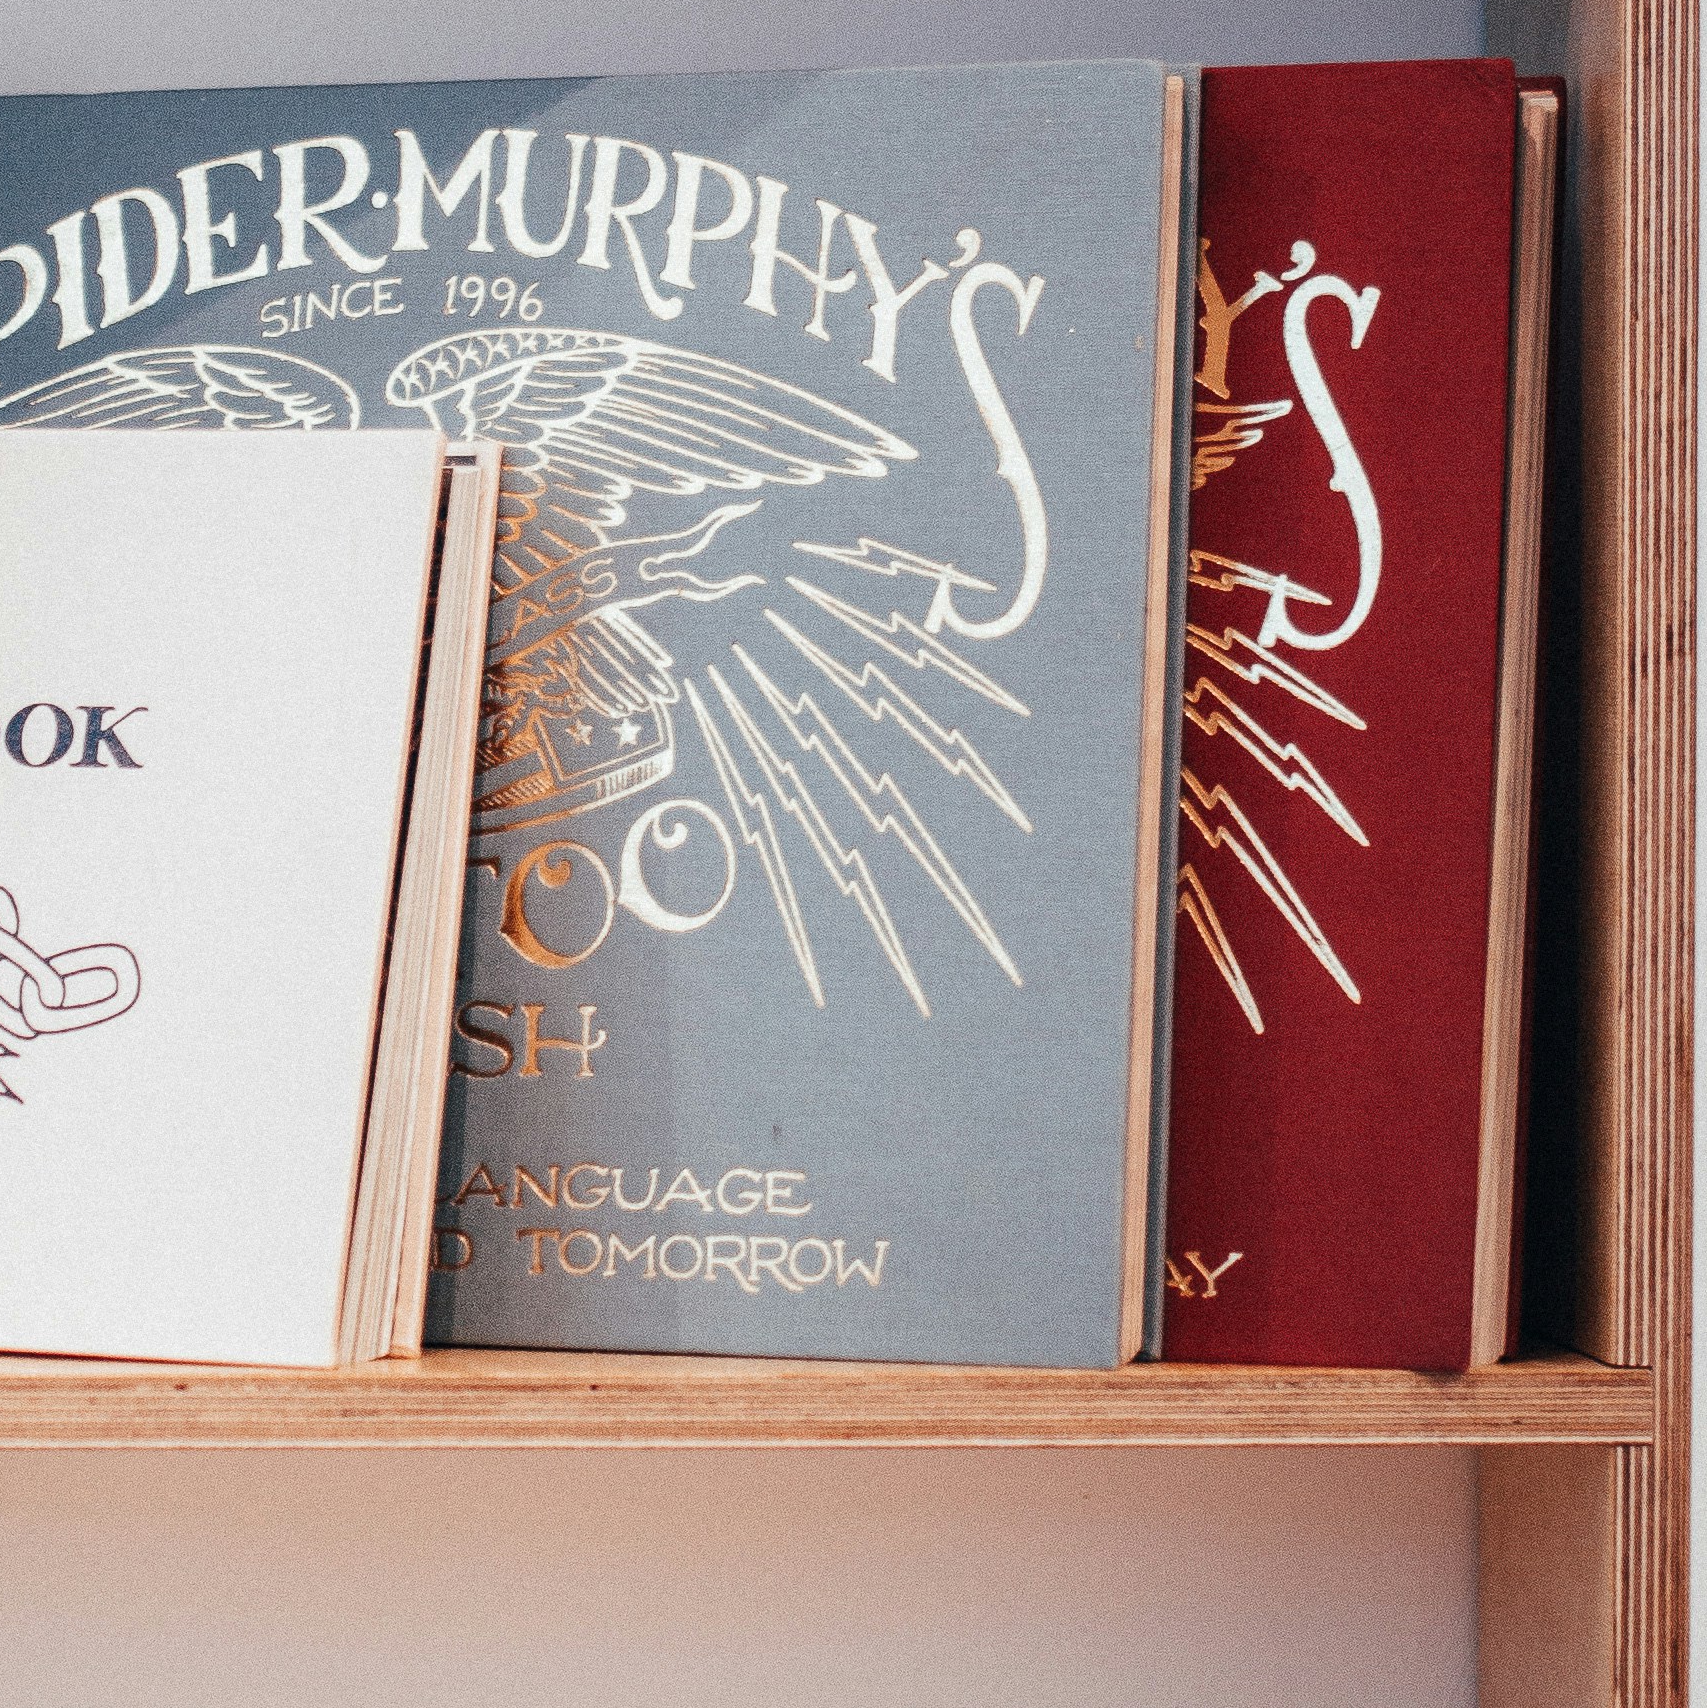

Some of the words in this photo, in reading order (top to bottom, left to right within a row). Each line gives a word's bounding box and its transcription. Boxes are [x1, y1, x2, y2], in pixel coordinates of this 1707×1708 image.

[261, 277, 405, 340] SINCE
[444, 273, 546, 324] 1996
[435, 1161, 813, 1215] ANGUAGE
[516, 1227, 892, 1296] TOMORROW
